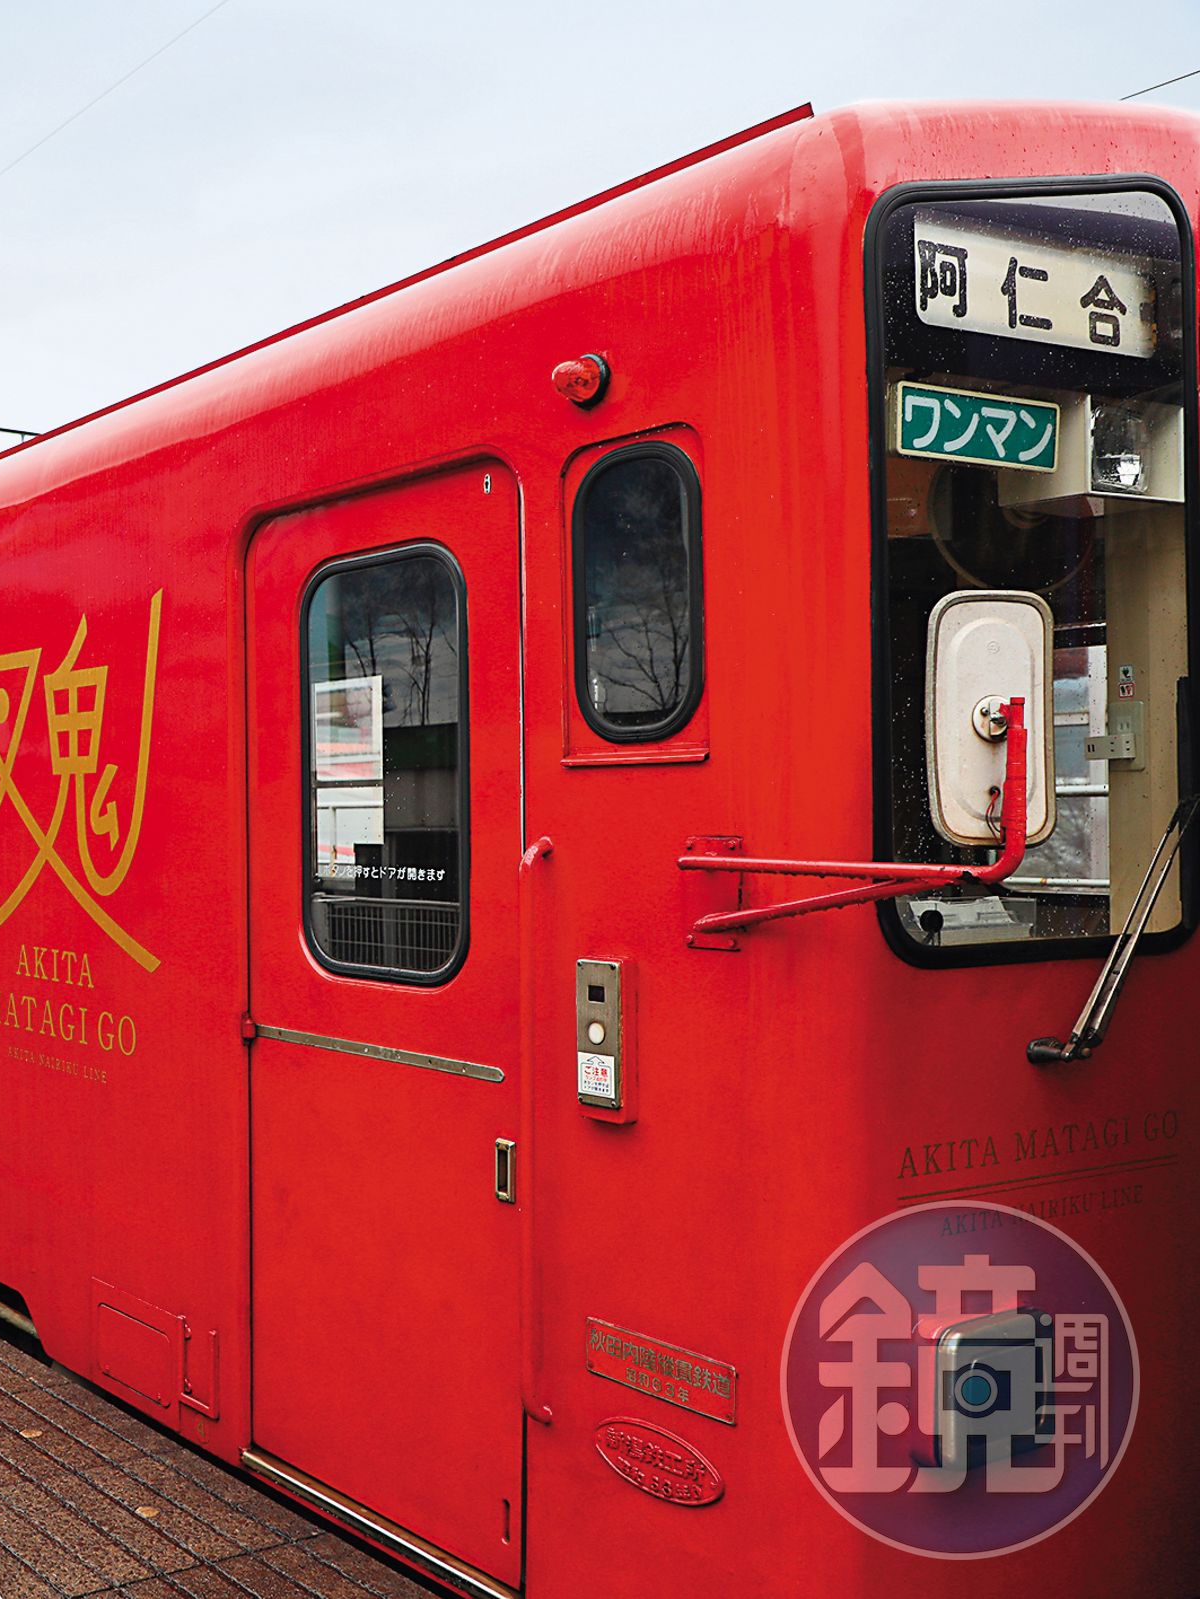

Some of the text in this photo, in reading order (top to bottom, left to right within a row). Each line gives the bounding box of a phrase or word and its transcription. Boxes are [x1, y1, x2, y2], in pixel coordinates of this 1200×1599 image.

[917, 239, 1128, 347] 阿仁合
[904, 395, 1053, 463] ワンマン
[16, 944, 95, 989] AKITA
[98, 1011, 137, 1056] GO
[897, 1109, 1180, 1180] AKITA MATAGI GO
[941, 1211, 1004, 1238] AKITA
[1101, 1184, 1144, 1212] LINE
